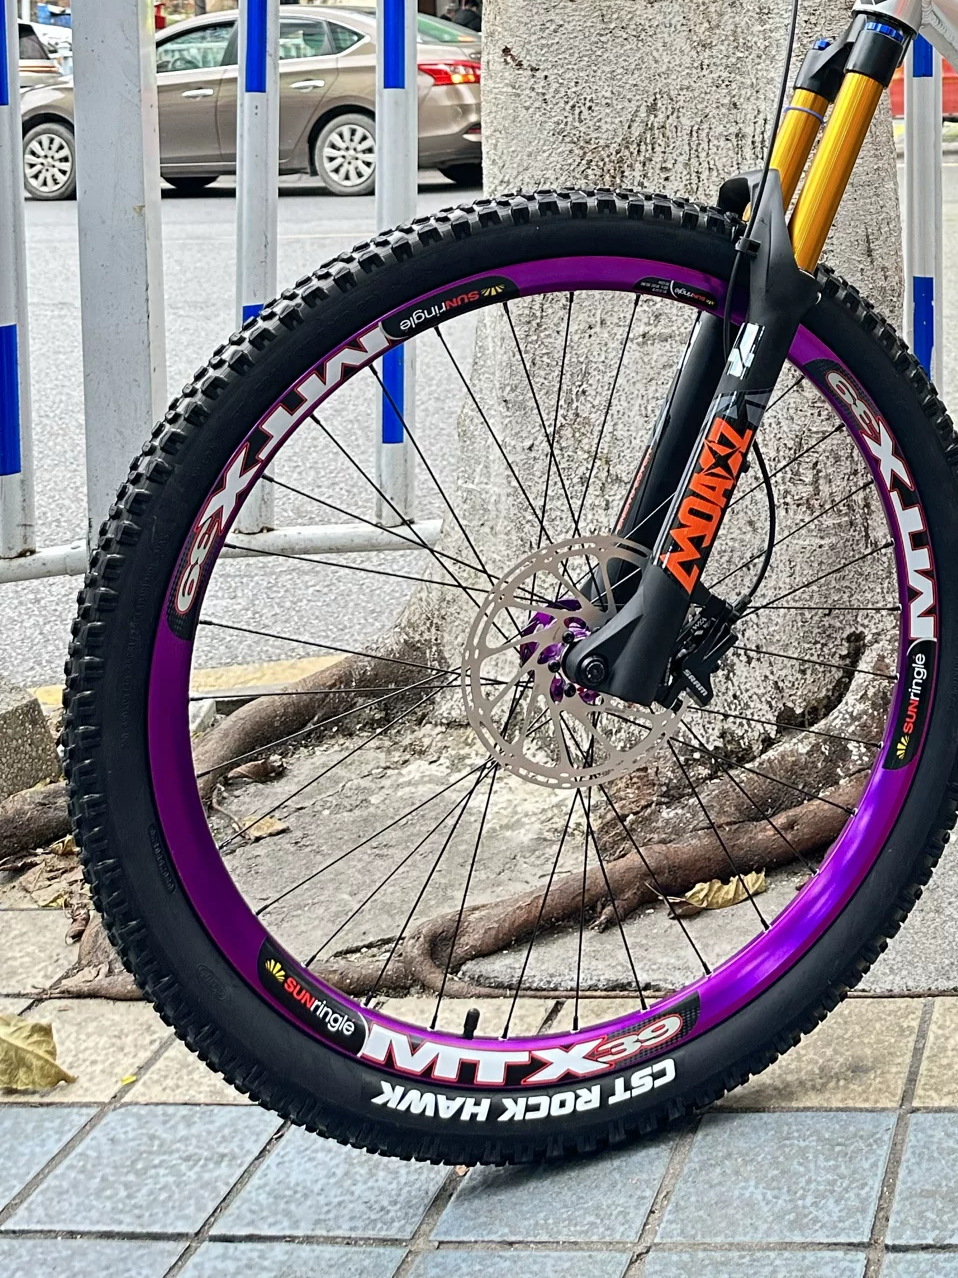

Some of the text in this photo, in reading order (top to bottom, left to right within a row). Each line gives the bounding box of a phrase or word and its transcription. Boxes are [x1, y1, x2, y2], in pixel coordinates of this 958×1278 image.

[683, 668, 708, 697] SRAM
[371, 1058, 677, 1122] CST ROCK HAWK
